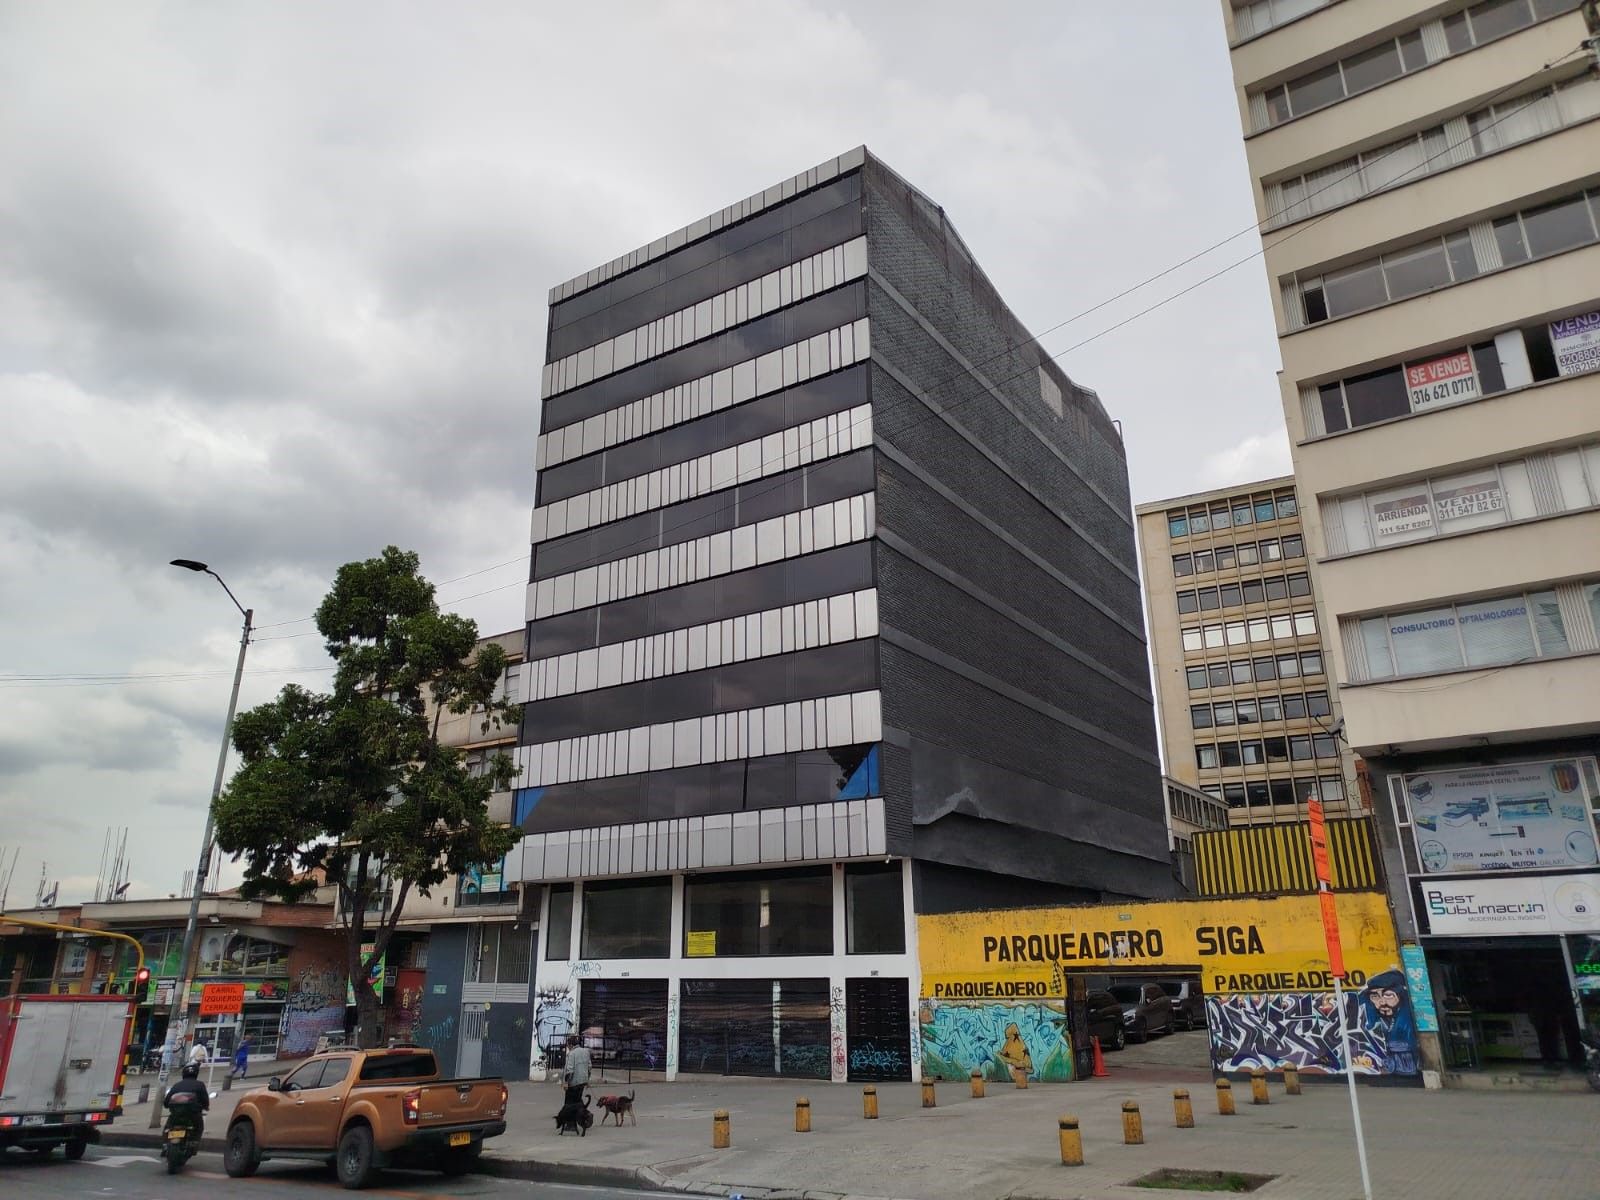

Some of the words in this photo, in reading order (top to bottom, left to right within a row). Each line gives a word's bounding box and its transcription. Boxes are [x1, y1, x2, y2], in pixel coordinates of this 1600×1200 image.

[1410, 368, 1427, 384] SE
[1430, 356, 1470, 379] VENDE
[1413, 389, 1430, 405] 316
[1433, 383, 1450, 400] 621
[1452, 376, 1475, 396] 0717
[1437, 490, 1500, 509] VENDE
[1377, 504, 1428, 523] ARRIENDA
[1439, 508, 1455, 519] 311
[1458, 504, 1474, 516] 547
[1390, 618, 1456, 635] CONSULTORIO
[1459, 607, 1527, 625] OFTALMOLOGICO
[983, 929, 1164, 963] PARQUEADERO
[1196, 925, 1265, 956] SIGA
[934, 980, 1047, 997] PARQUEADERO
[1214, 969, 1366, 991] PARQUEADERO
